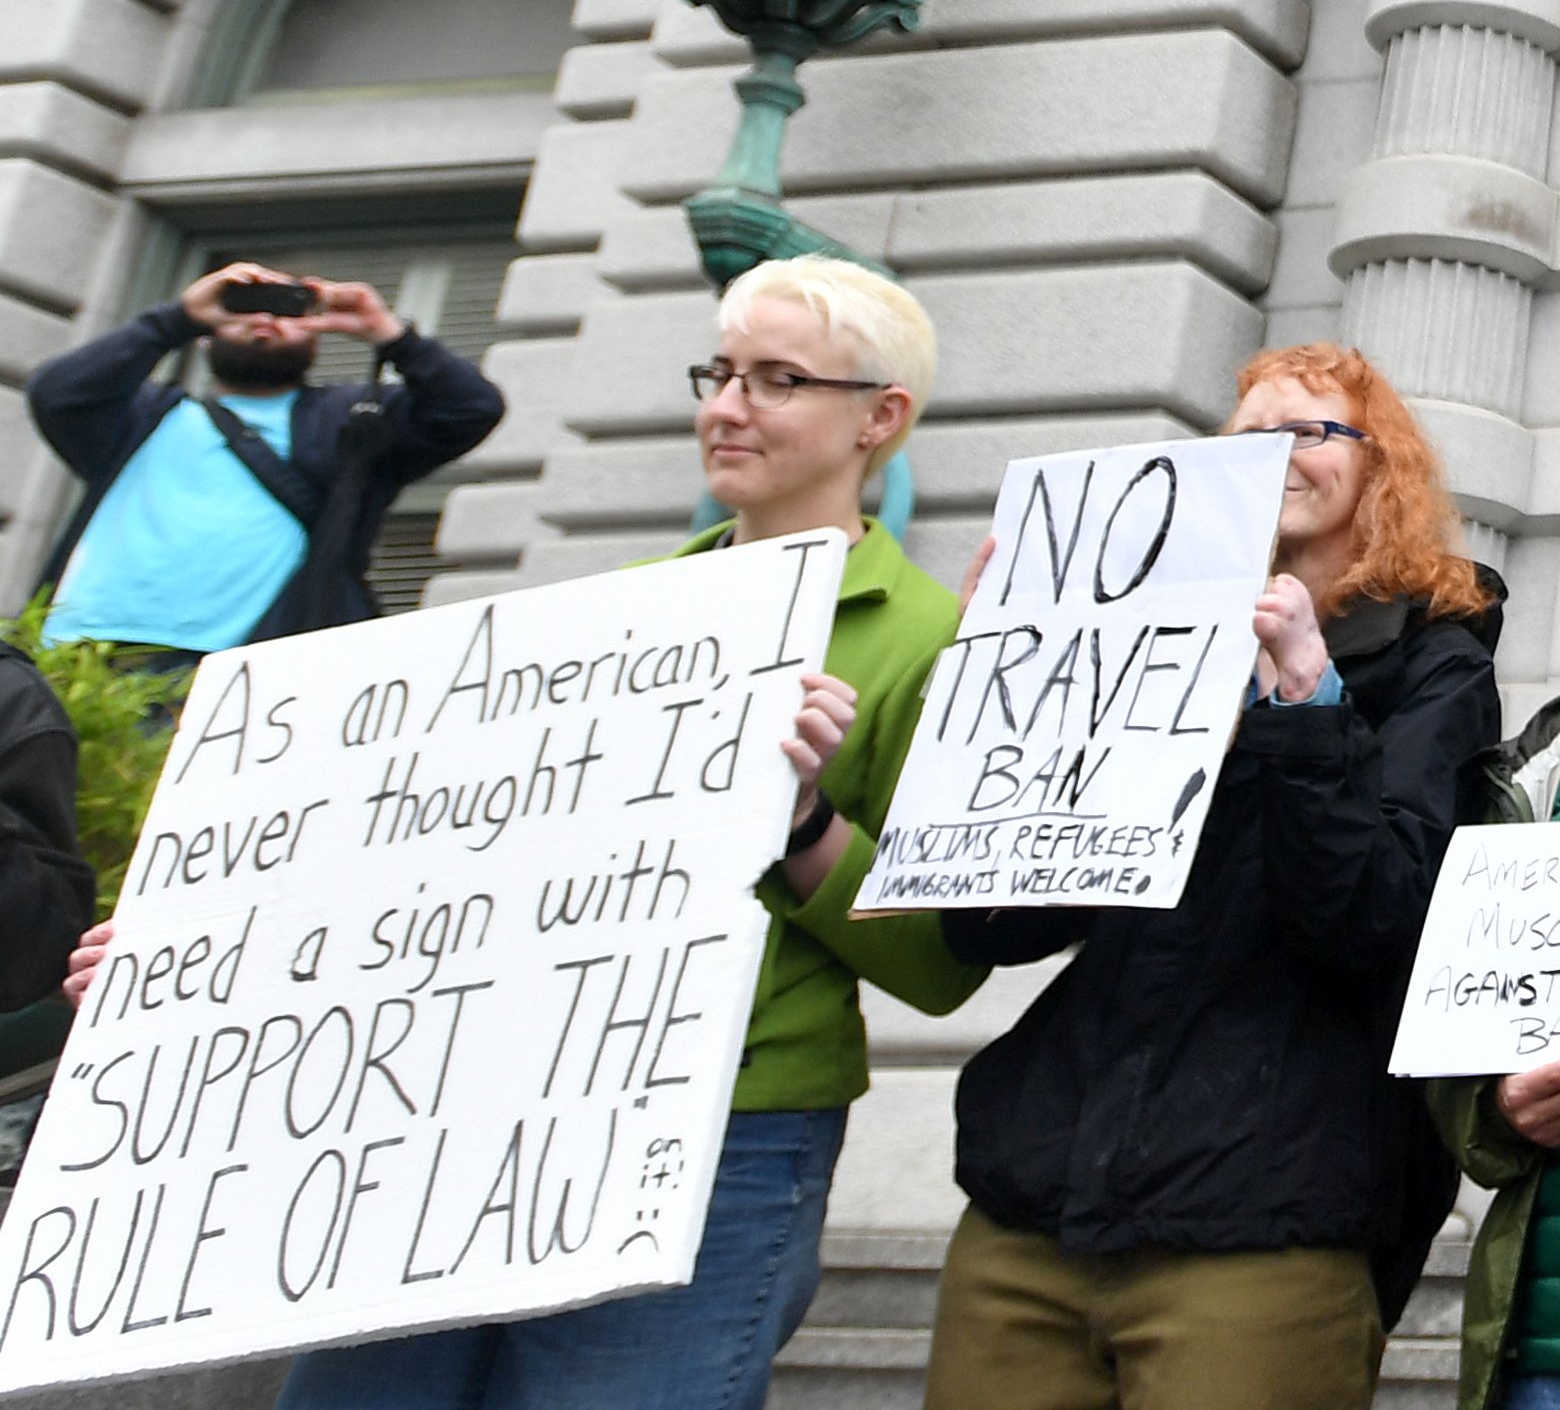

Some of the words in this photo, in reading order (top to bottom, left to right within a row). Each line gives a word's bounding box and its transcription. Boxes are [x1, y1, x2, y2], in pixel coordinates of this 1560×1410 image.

[1000, 455, 1177, 606] NO
[175, 661, 297, 785] As
[341, 678, 409, 747] an
[425, 603, 732, 733] American,
[749, 540, 829, 676] I
[937, 623, 1219, 745] TRAVEL
[136, 797, 329, 896] never
[363, 718, 603, 851] thought
[624, 692, 754, 807] I'd
[966, 744, 1112, 814] BAN
[1009, 823, 1164, 861] REFUGEES
[90, 905, 257, 1028] need
[291, 925, 328, 983] a
[359, 881, 495, 992] sign
[537, 838, 692, 933] with
[877, 870, 1000, 903] IMMIGRANTS
[60, 980, 495, 1172] "SUPPORT
[540, 934, 729, 1100] THE
[646, 1137, 682, 1159] on
[0, 1163, 248, 1349] RULE
[279, 1135, 404, 1304] OF
